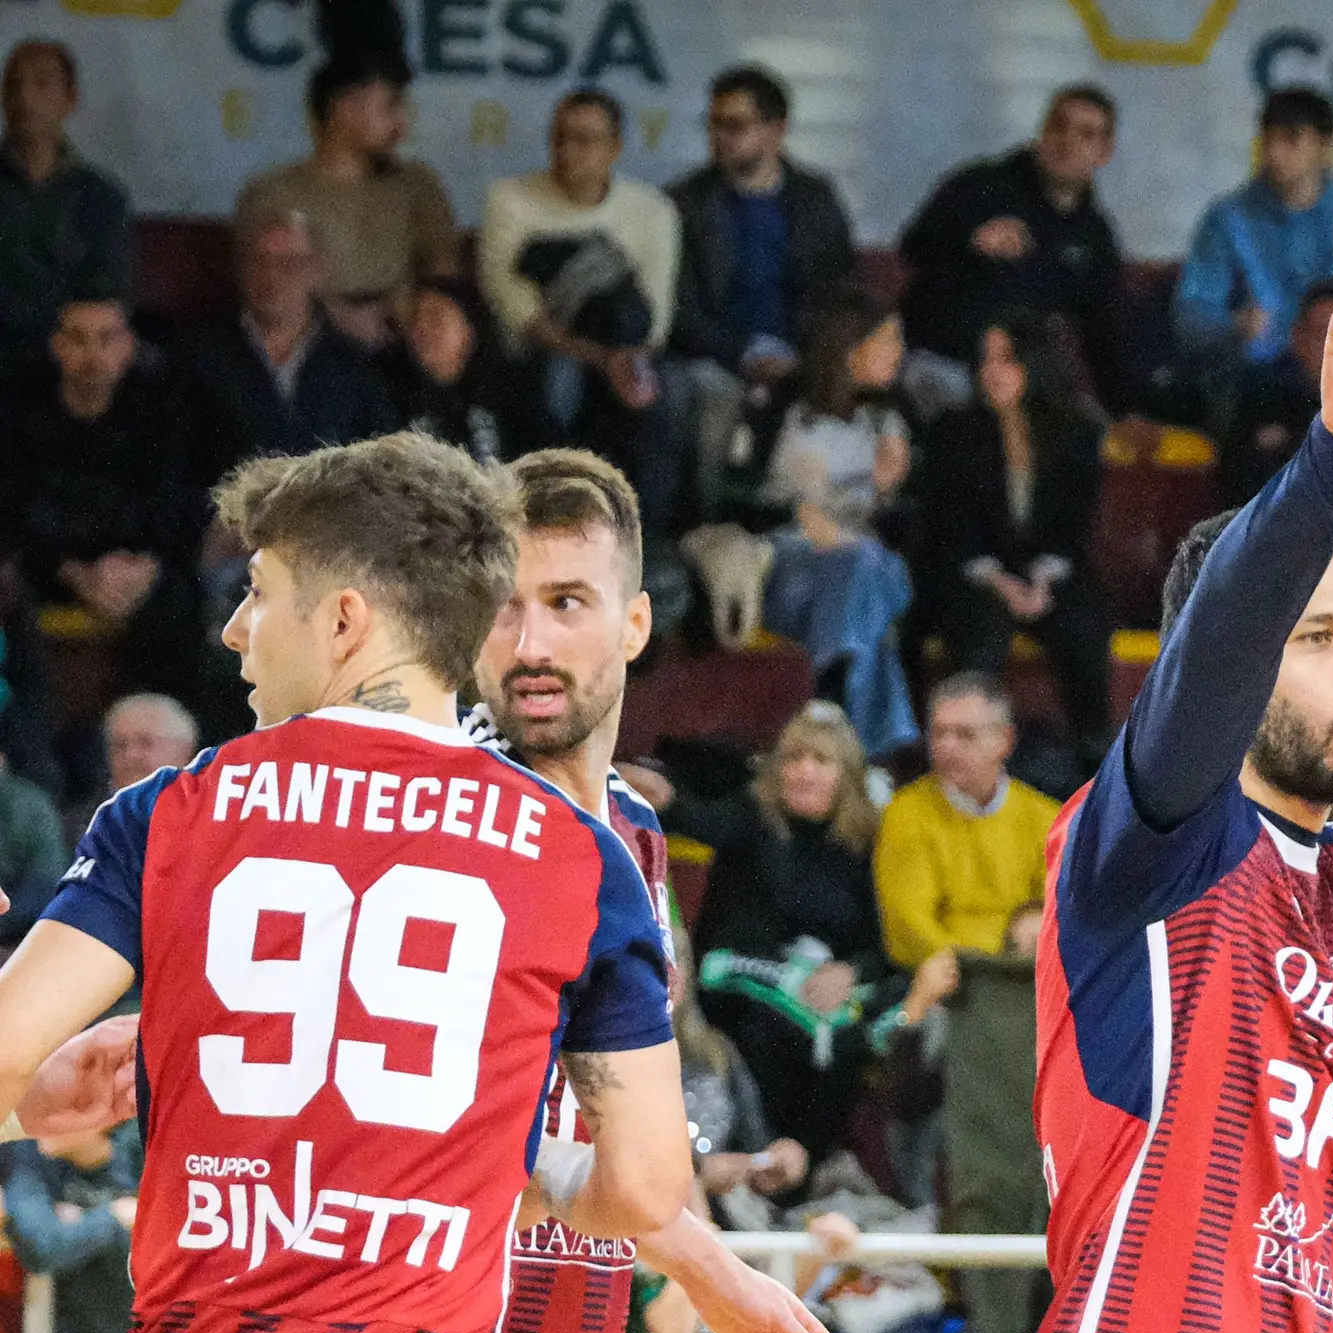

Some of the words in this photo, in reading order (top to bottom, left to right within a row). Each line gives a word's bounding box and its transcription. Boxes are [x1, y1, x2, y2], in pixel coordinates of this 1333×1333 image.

[226, 0, 669, 86] CESA
[213, 761, 547, 860] FANTECELE
[198, 856, 507, 1134] 99
[177, 1140, 471, 1273] BINETTI
[185, 1154, 271, 1179] GRUPPO
